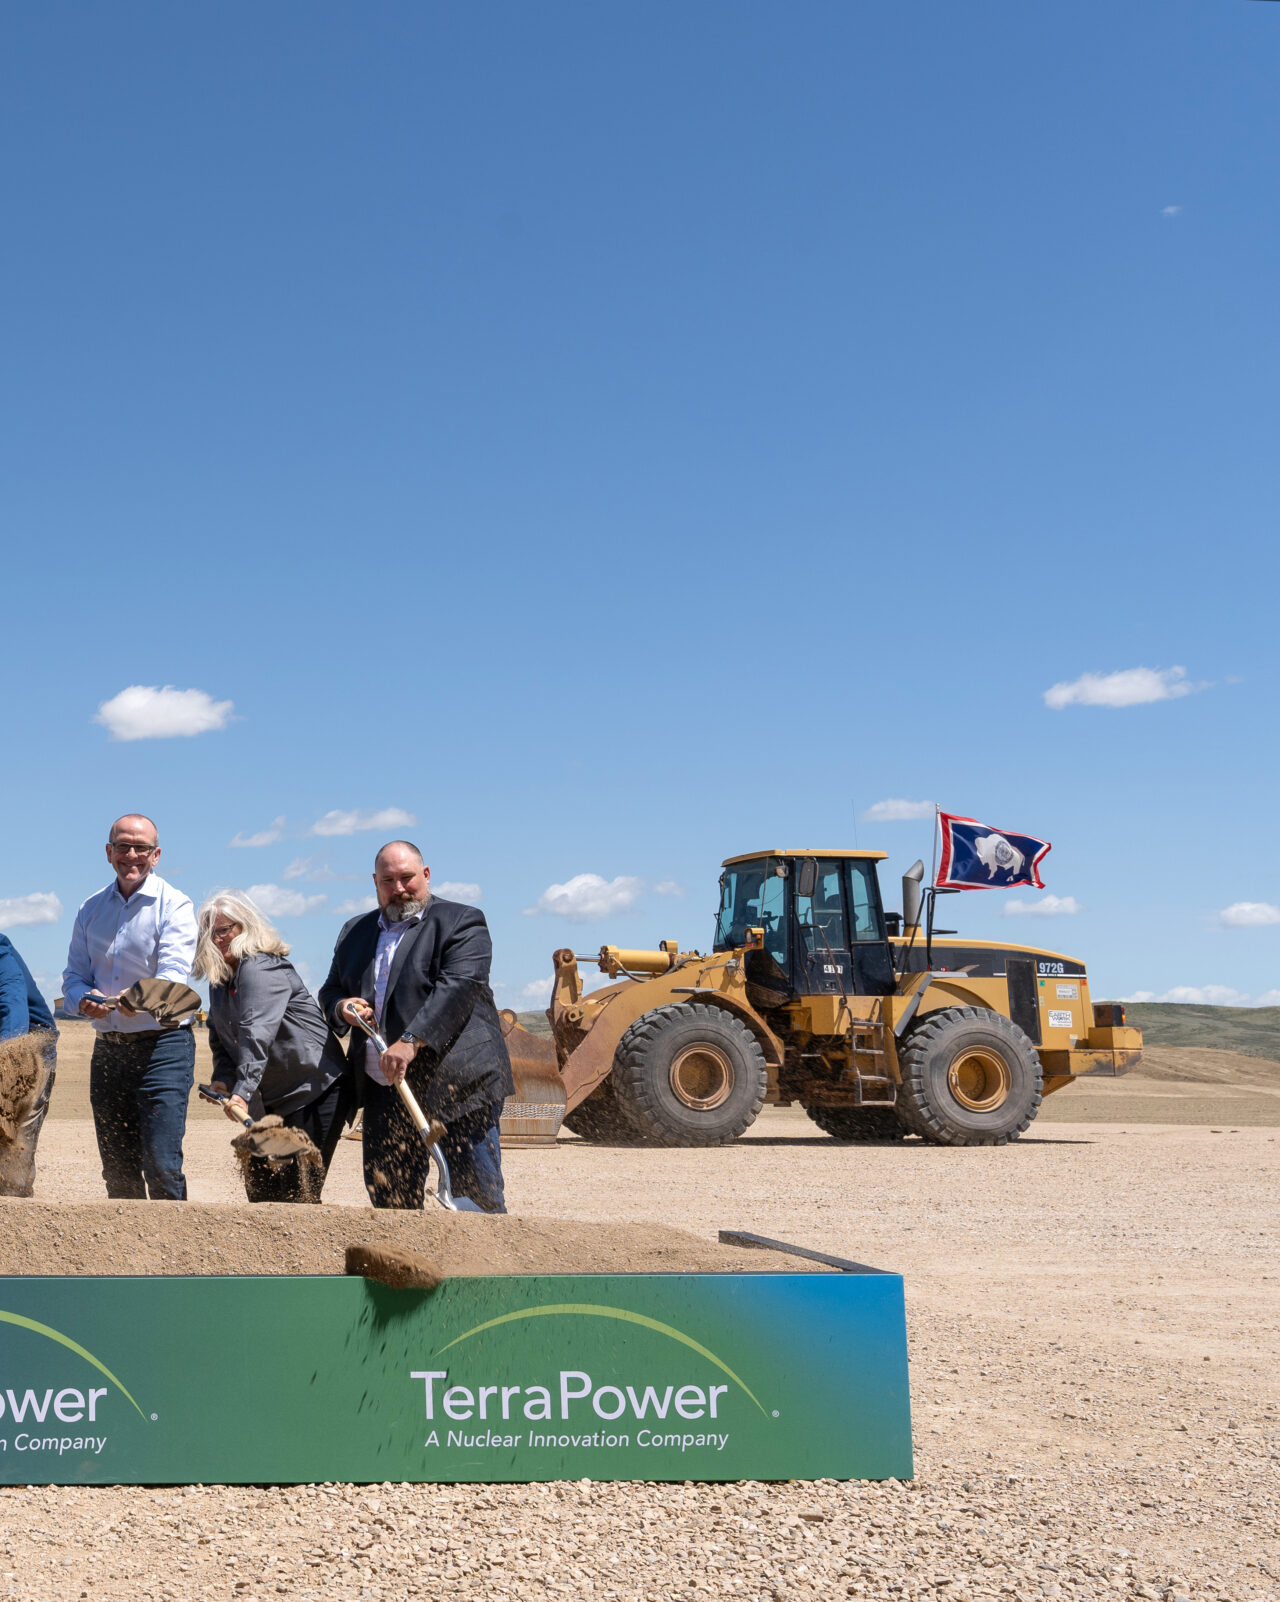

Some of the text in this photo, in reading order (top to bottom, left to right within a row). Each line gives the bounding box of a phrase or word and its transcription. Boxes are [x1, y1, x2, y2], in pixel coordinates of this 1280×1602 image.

[1039, 962, 1064, 974] 972G
[410, 1370, 728, 1421] TerraPower
[15, 1433, 107, 1457] Company
[425, 1429, 729, 1453] A Nuclear Innovation Company
